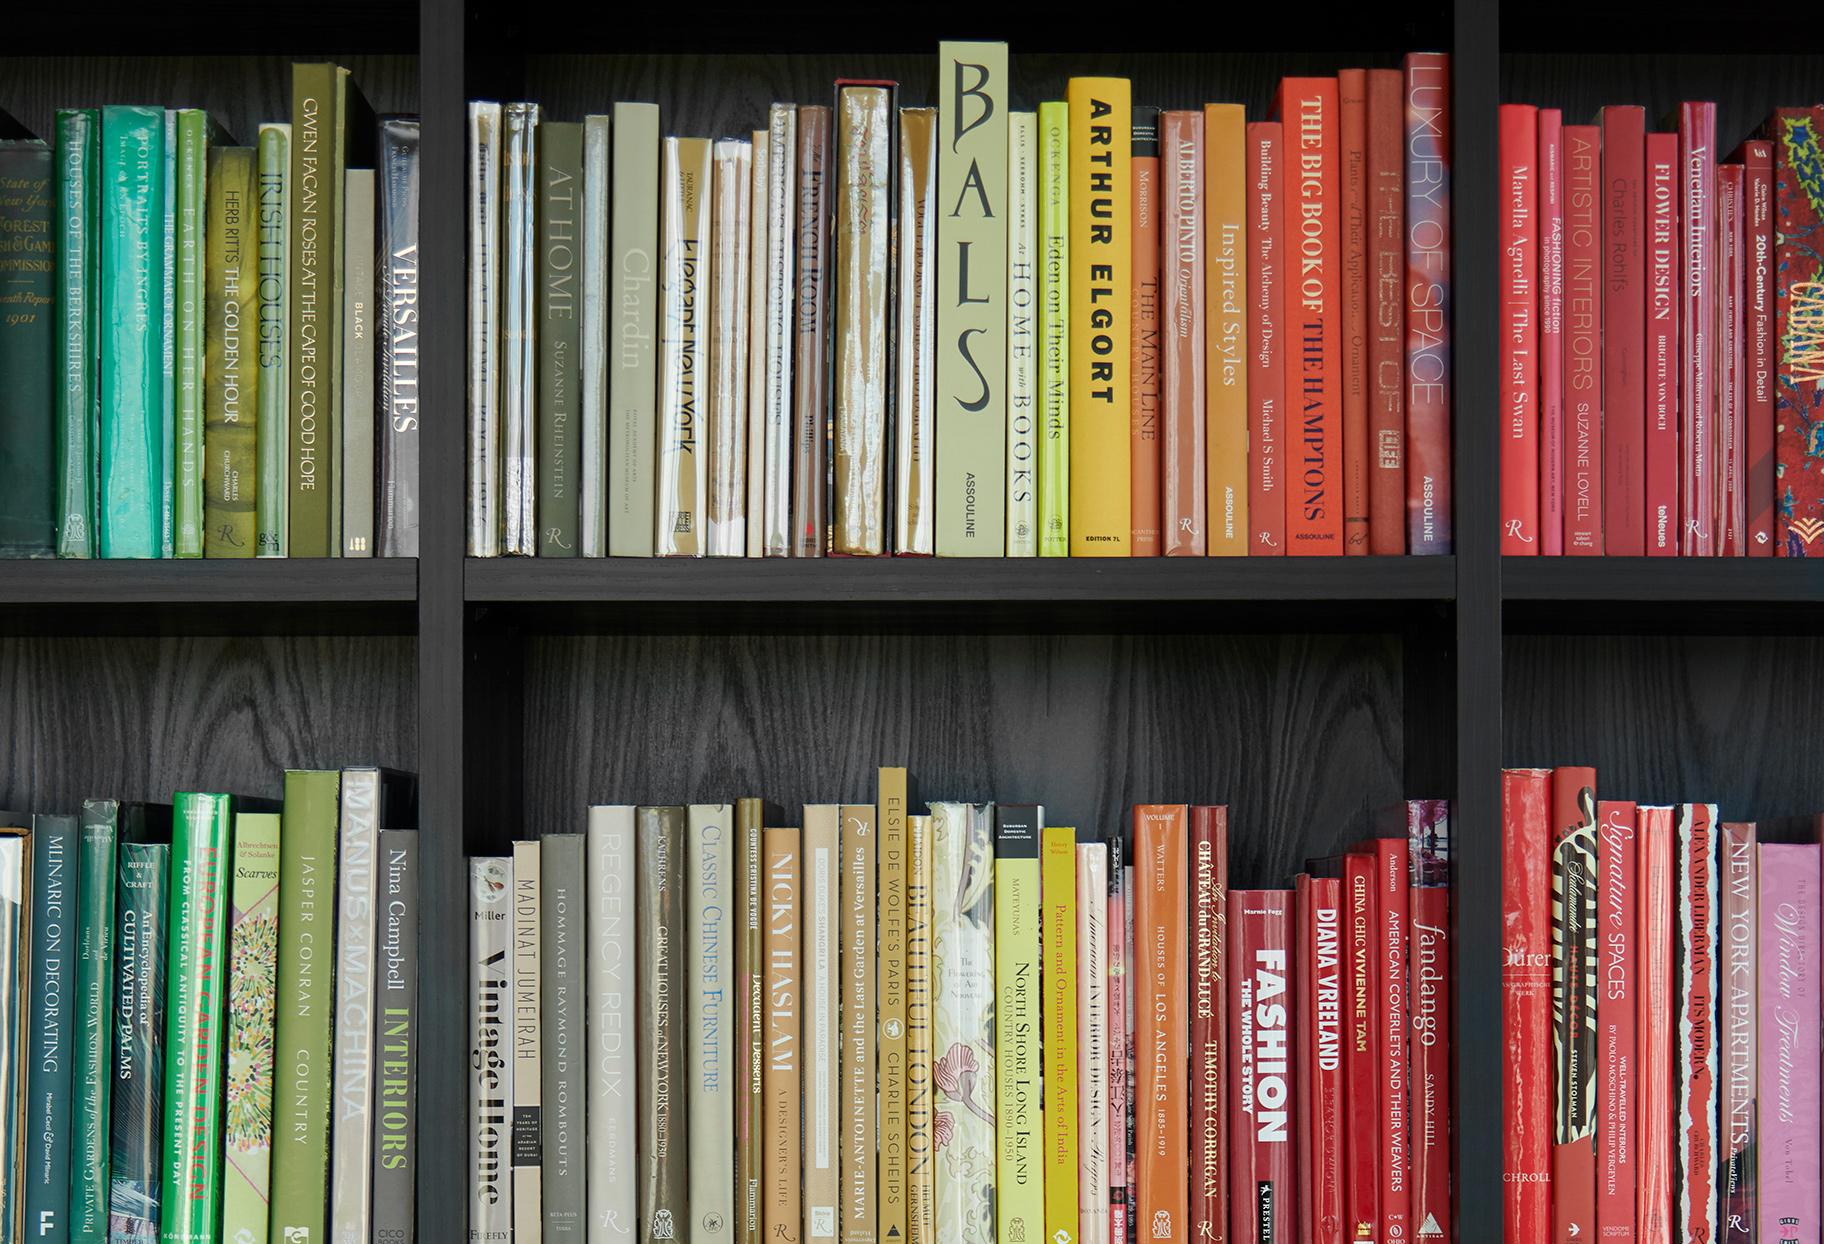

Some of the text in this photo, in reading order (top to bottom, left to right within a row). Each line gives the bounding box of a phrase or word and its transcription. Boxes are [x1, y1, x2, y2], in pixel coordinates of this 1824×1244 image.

[300, 98, 317, 490] GWEN FAGAN ROSES AT THE CAPE OF GOOD HOPE
[548, 166, 572, 320] AT HOME
[621, 247, 650, 370] Chardin
[948, 59, 995, 412] BALS
[1091, 99, 1112, 404] ARTHUR ELGORT
[1216, 223, 1240, 386] Inspired Styles
[1300, 96, 1325, 520] THE BIG BOOK OF THE HAMPTONS
[1411, 66, 1443, 405] LUXURY OF SPACE
[1507, 165, 1527, 295] Marella Agnelli
[1655, 163, 1669, 320] FLOWER DESIGN
[354, 302, 364, 339] BLACK
[392, 243, 417, 433] VERSAILLES
[1047, 235, 1065, 439] Eden on Their Minds
[1512, 309, 1527, 439] The Last Swan
[1754, 235, 1767, 402] 20th-Century Fashion in Detail
[554, 341, 567, 498] SUZANNE RHEINSTEIN
[965, 472, 975, 538] ASSOULINE
[1423, 476, 1433, 541] ASSOULINE
[1657, 505, 1667, 547] teNeues
[43, 835, 63, 1072] MLINARIC ON DECORATING
[384, 849, 407, 990] Nina Campbell
[518, 880, 535, 1059] MADINAT JUMEIRAH
[601, 834, 622, 1097] REGENCY REDUX
[771, 851, 793, 1072] NICKY HASLAM
[887, 797, 900, 1005] ELSIE DE WOLFE'S PARIS
[1414, 919, 1446, 1046] fandango
[1608, 934, 1623, 999] SPACES
[120, 910, 136, 1079] CULTIVATED PALMS
[294, 856, 315, 1145] JASPER CONRAN COUNTRY
[558, 888, 568, 1176] HOMMAGE RAYMOND ROMBOUTS
[1241, 978, 1252, 1114] THE WHOLE STORY
[1255, 949, 1287, 1142] FASHION
[1317, 909, 1338, 1070] DIANA VREELAND
[1730, 842, 1750, 1144] NEW YORK APARTMENTS
[382, 1007, 409, 1170] INTERIORS
[887, 1052, 900, 1204] CHARLIE SCHEIPS
[1262, 1197, 1271, 1240] PRESTEL
